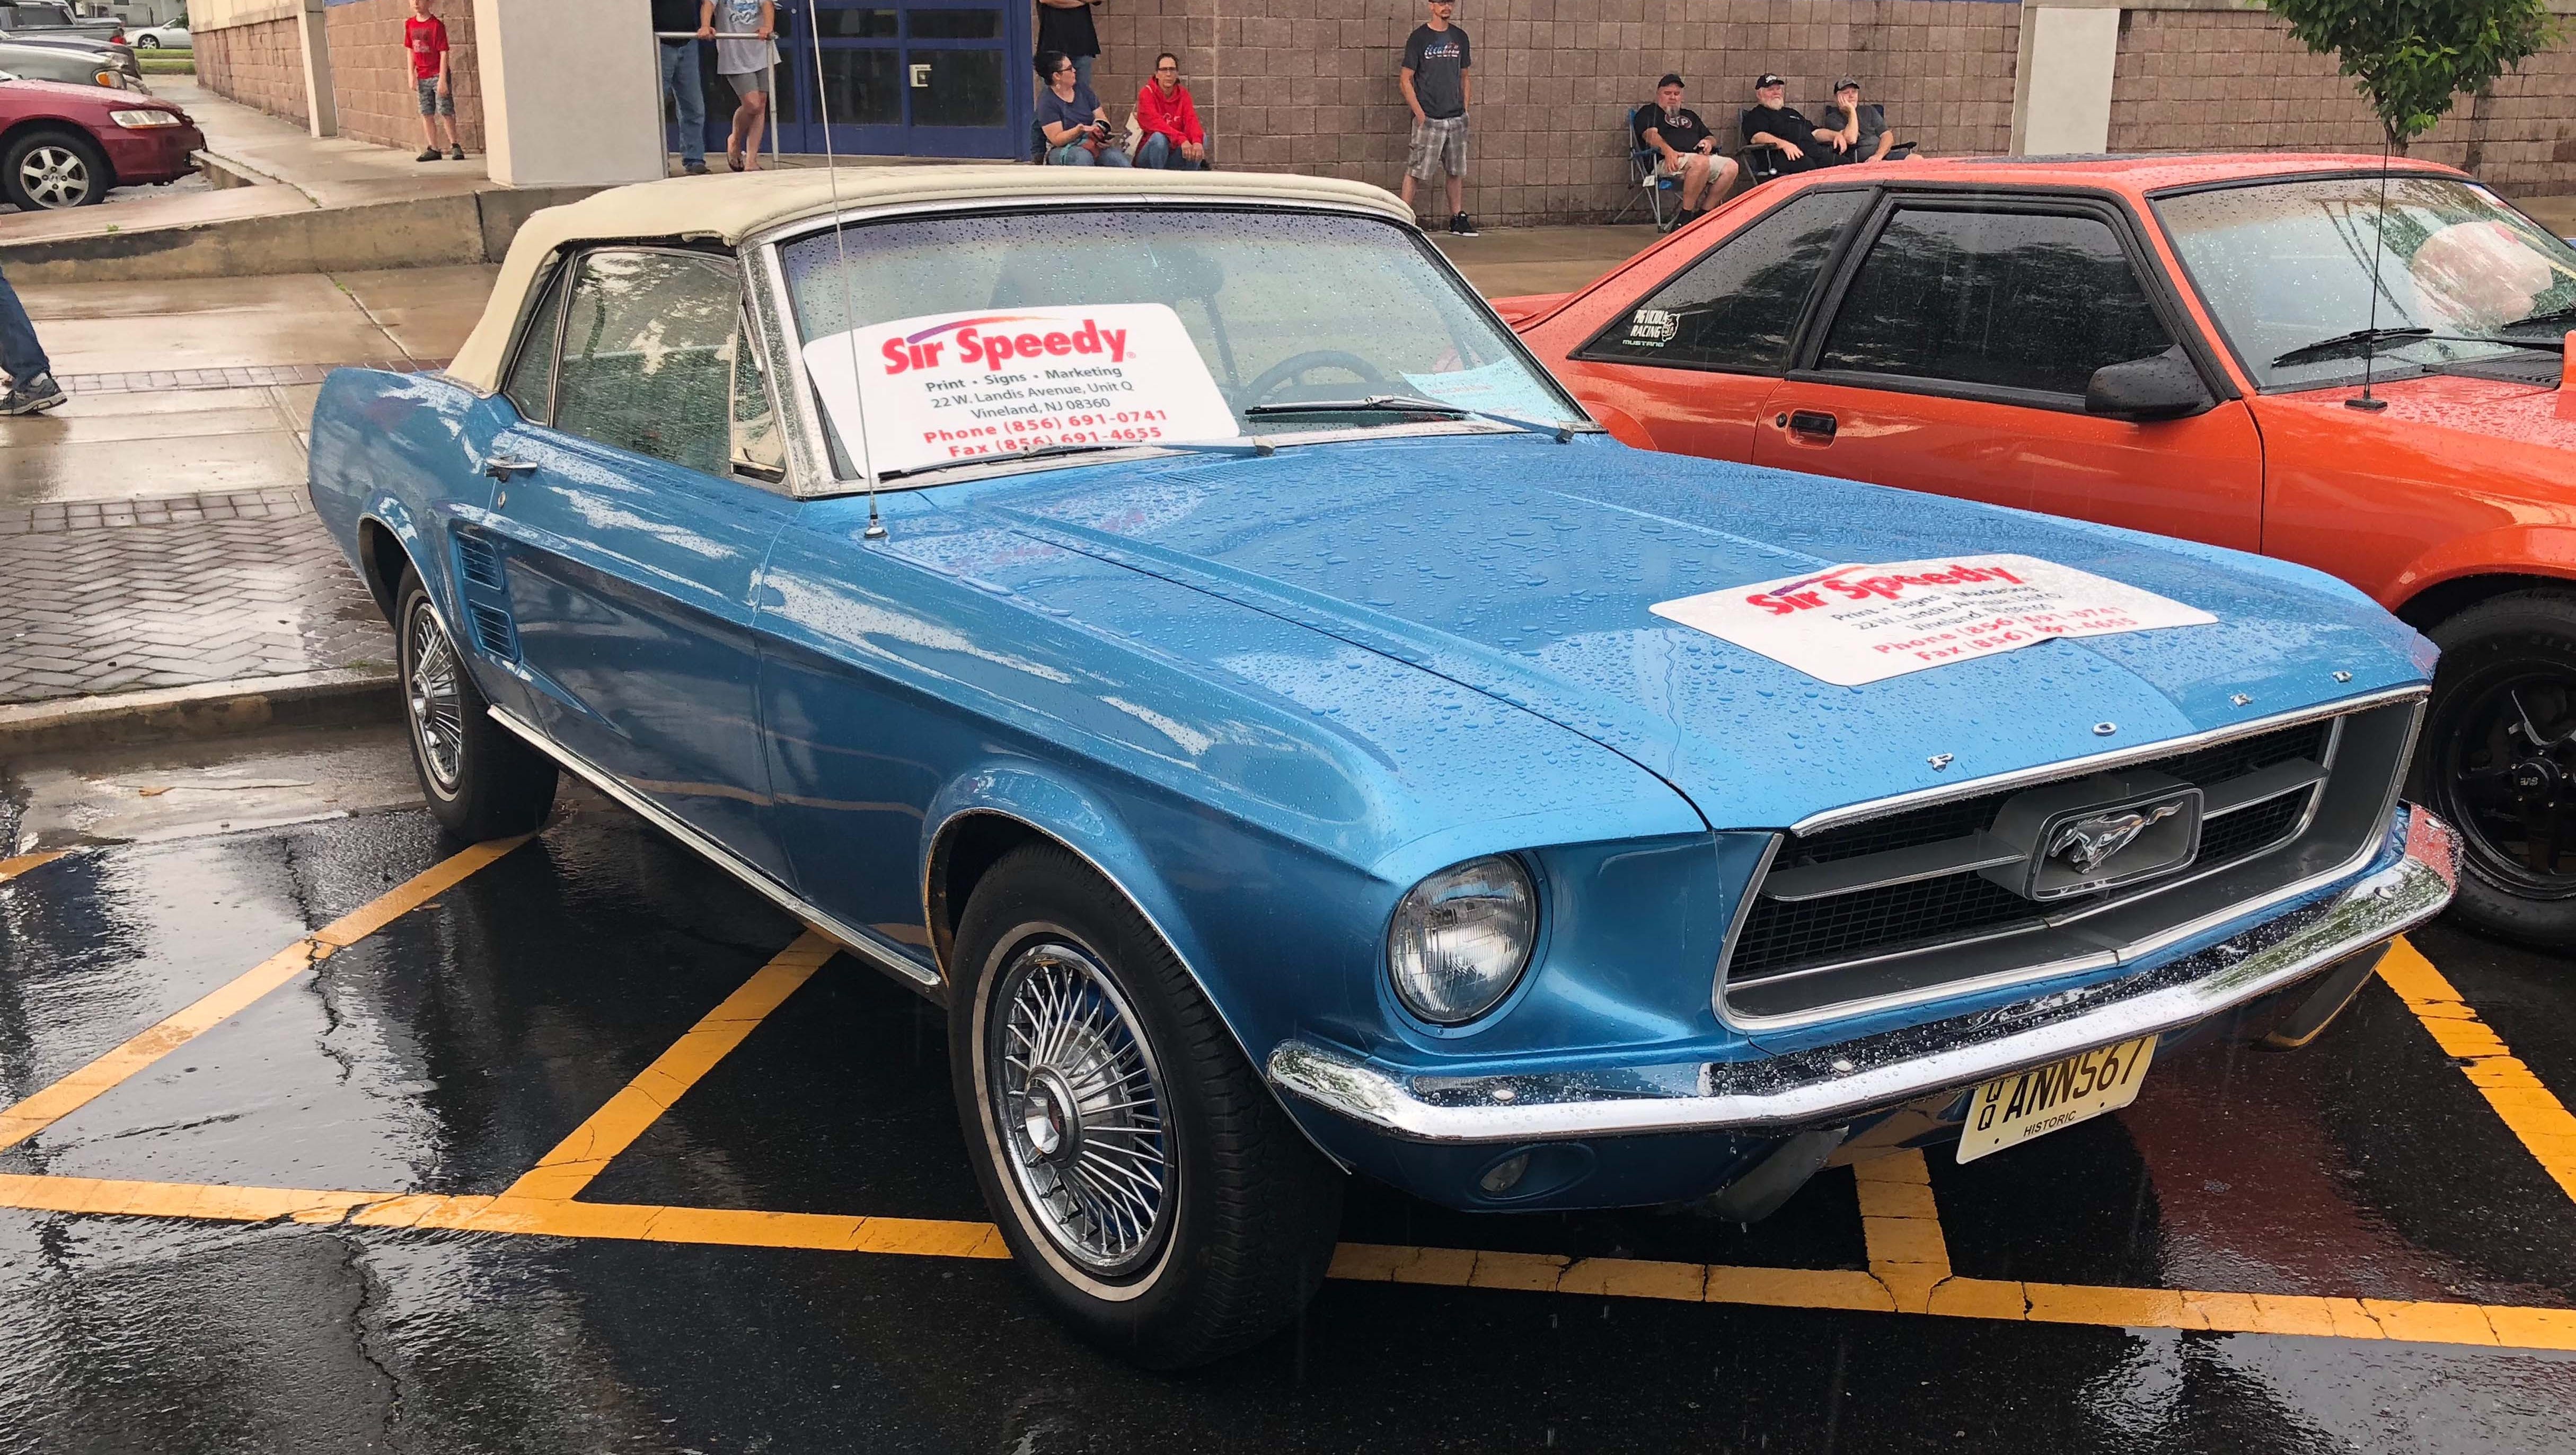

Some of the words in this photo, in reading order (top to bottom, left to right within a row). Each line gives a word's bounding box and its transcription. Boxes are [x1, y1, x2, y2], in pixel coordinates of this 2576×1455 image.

[1670, 117, 1688, 126] STP
[1622, 339, 1664, 348] MUSTANG
[1630, 325, 1662, 338] RACING
[881, 337, 945, 375] Sir
[956, 320, 1126, 371] Speedy
[925, 379, 966, 392] Print
[984, 373, 1027, 386] Signs
[1045, 367, 1122, 379] Marketing
[931, 397, 951, 409] 22
[952, 394, 973, 405] W.
[974, 389, 1025, 403] Landis
[1028, 384, 1086, 397] Avenue,
[1088, 382, 1119, 393] Unit
[1121, 381, 1134, 392] Q
[971, 403, 1043, 419] Vineland,
[1045, 401, 1063, 412] NJ
[1066, 398, 1111, 410] 08360
[923, 426, 997, 444] Phone
[1004, 417, 1062, 434] (856)
[1068, 410, 1167, 427] 691-0741
[948, 445, 989, 457] Fax
[995, 434, 1053, 453] (856)
[1061, 427, 1161, 443] 691-4655
[1746, 591, 1829, 615] Sir
[1823, 564, 2024, 600] Speedy
[1831, 607, 1880, 620] Print
[1891, 594, 1942, 608] Signs
[1851, 620, 1878, 630] 22
[1898, 605, 1954, 621] Landis
[1872, 633, 1957, 654] Phone
[1955, 613, 2024, 636] (856)
[1913, 646, 1965, 661] Fax
[1963, 629, 2033, 651] (856)
[1926, 670, 2353, 773] FORD
[2023, 1110, 2077, 1137] HISTORIC
